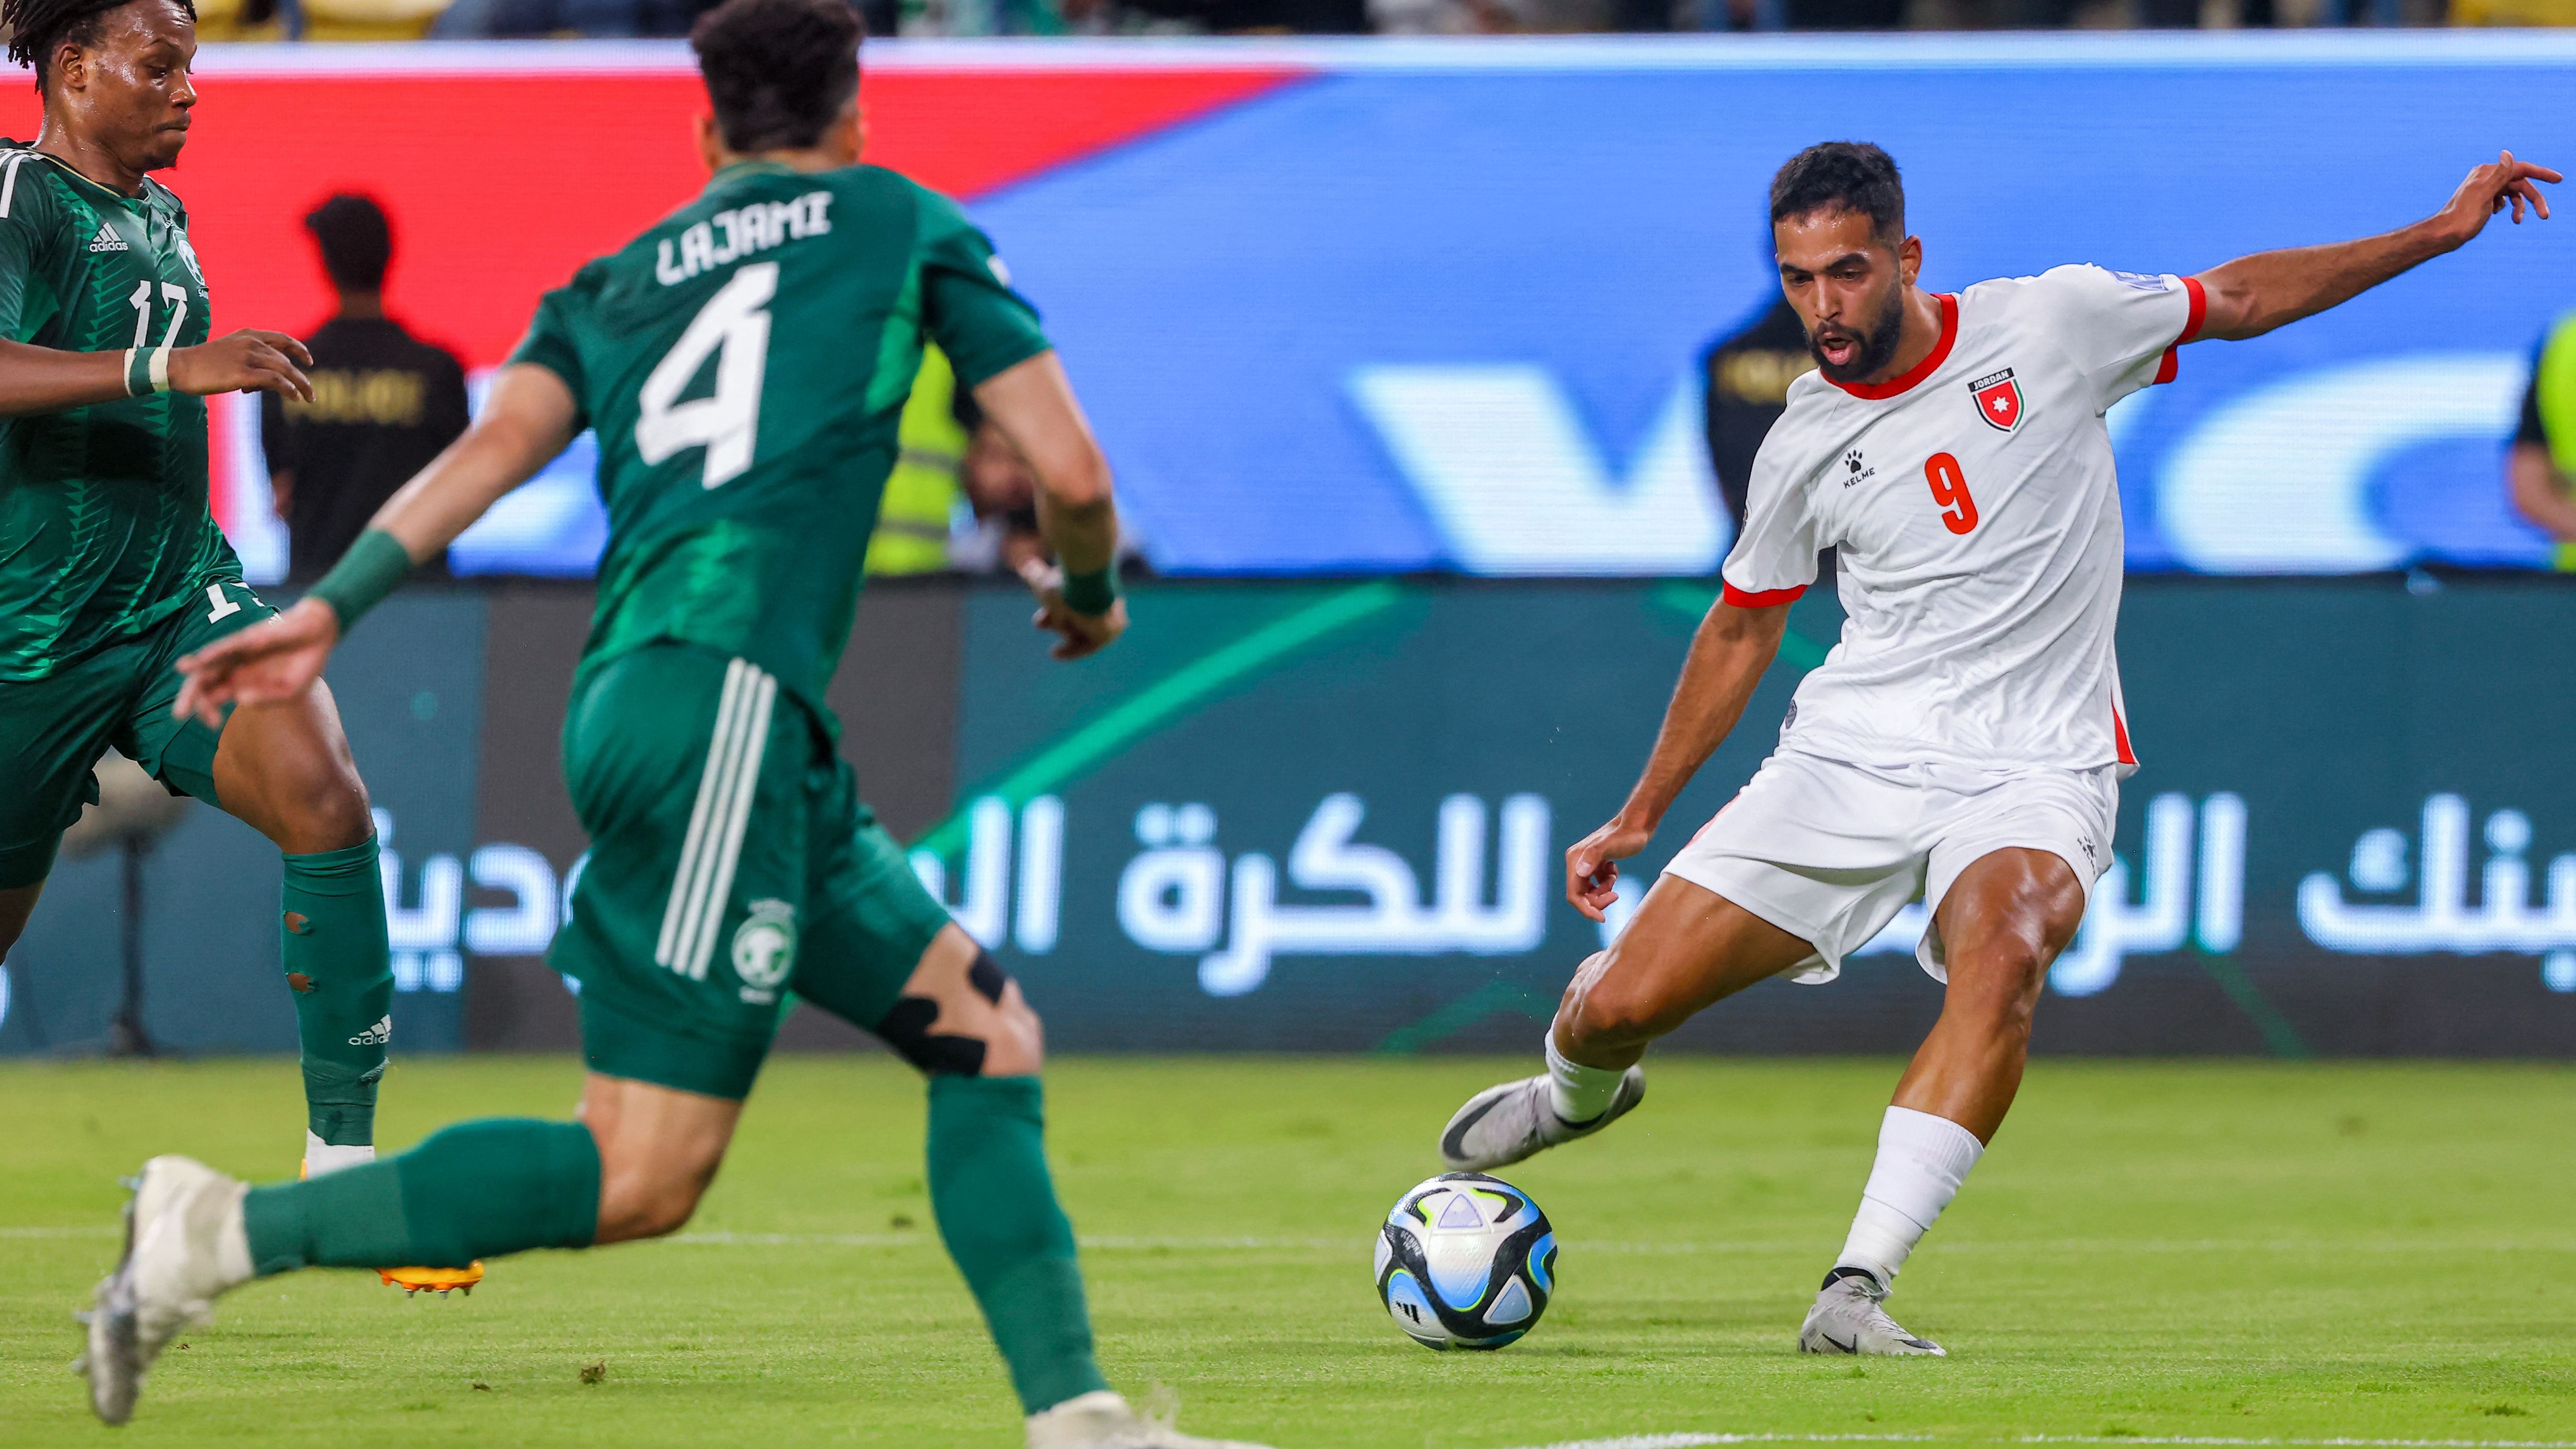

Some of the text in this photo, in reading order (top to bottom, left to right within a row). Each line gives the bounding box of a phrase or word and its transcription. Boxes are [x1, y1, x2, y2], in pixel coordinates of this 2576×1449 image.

[89, 240, 129, 252] adidas
[655, 191, 833, 287] LAJAMI
[129, 280, 188, 348] 17
[281, 368, 425, 425] OLICE
[635, 260, 779, 490] 4
[1974, 370, 2009, 390] JORDAN
[1843, 467, 1875, 489] KELME
[1924, 452, 1979, 535] 9
[1117, 793, 1550, 997] للكرة
